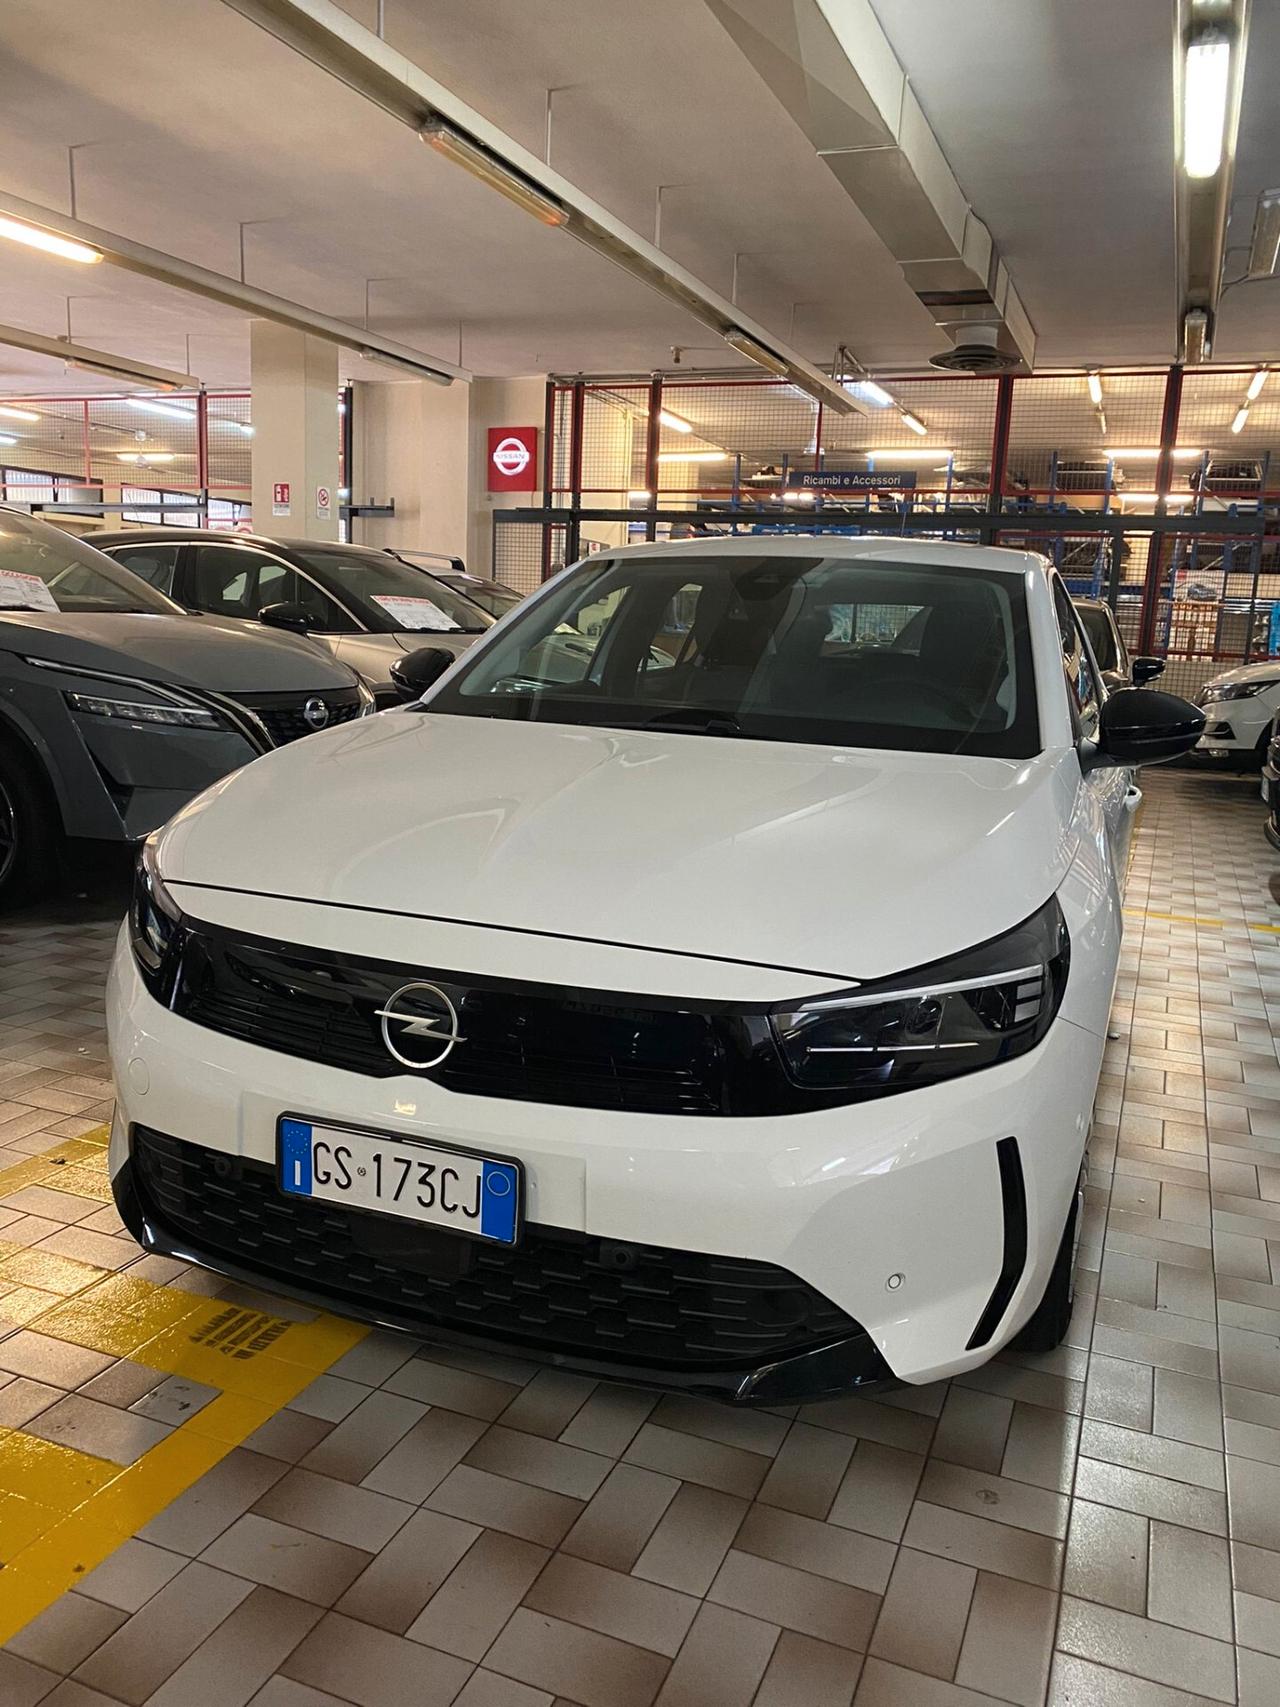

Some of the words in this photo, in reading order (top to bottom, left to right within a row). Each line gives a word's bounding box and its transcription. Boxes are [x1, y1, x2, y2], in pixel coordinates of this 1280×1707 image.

[803, 475, 841, 485] Ricambi
[843, 477, 850, 485] e
[852, 475, 901, 485] Accessori
